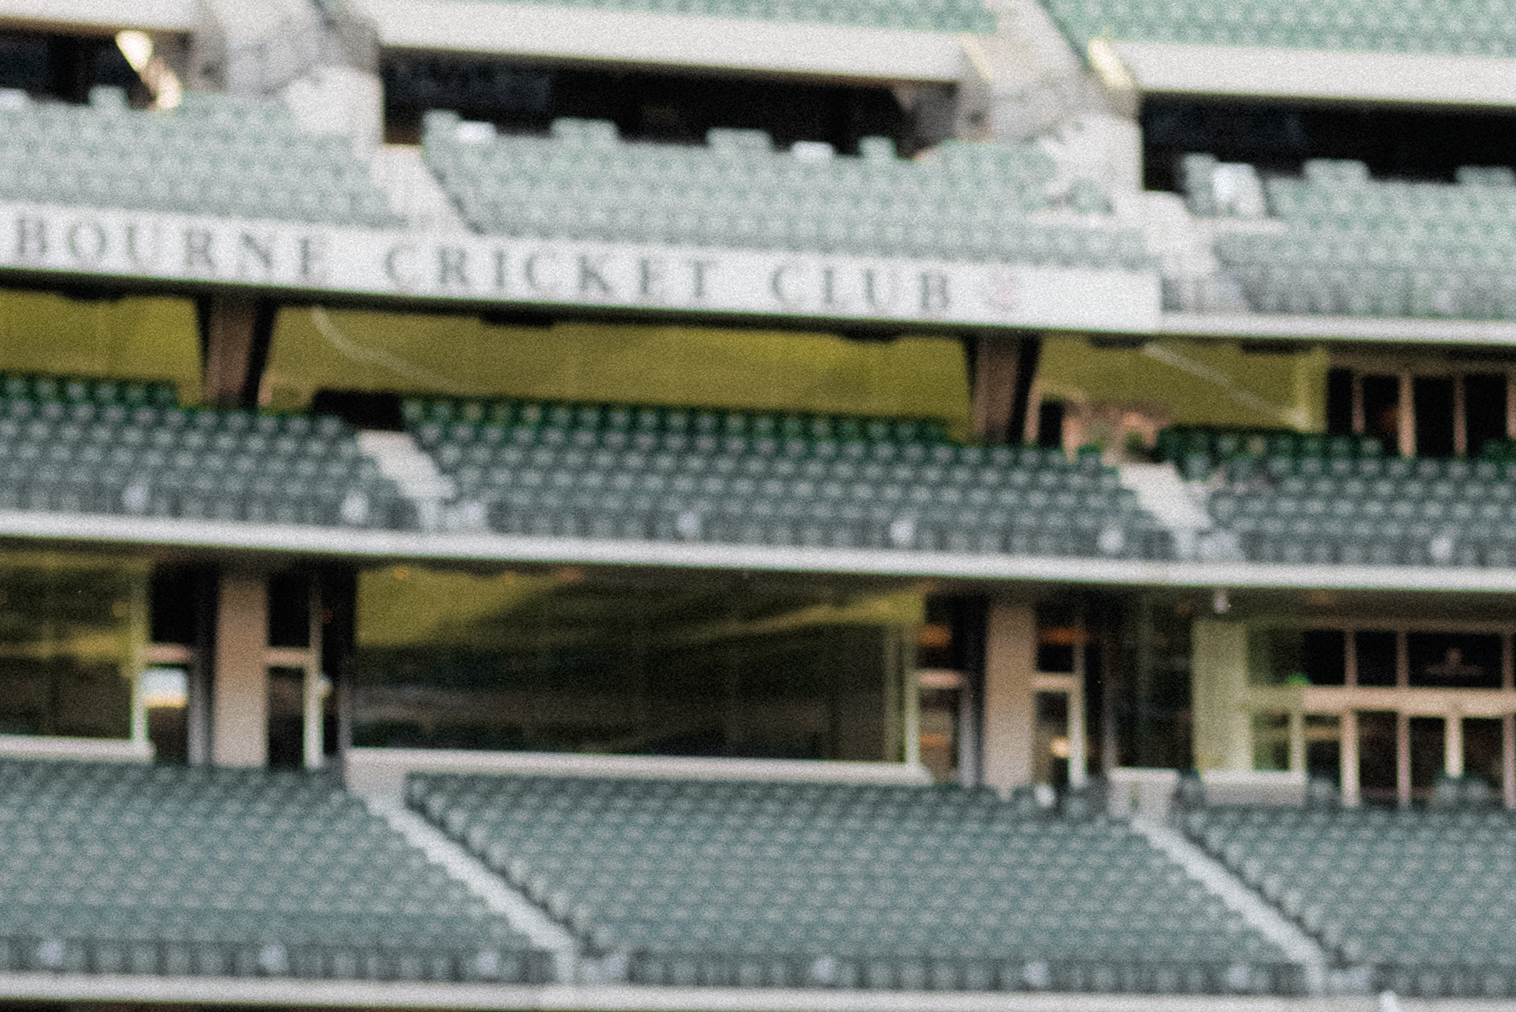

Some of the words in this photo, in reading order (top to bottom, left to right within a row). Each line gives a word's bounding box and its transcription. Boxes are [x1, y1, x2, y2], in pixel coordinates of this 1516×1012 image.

[14, 215, 324, 280] BOURNE
[384, 234, 720, 300] CRICKET
[770, 264, 954, 314] CLUB
